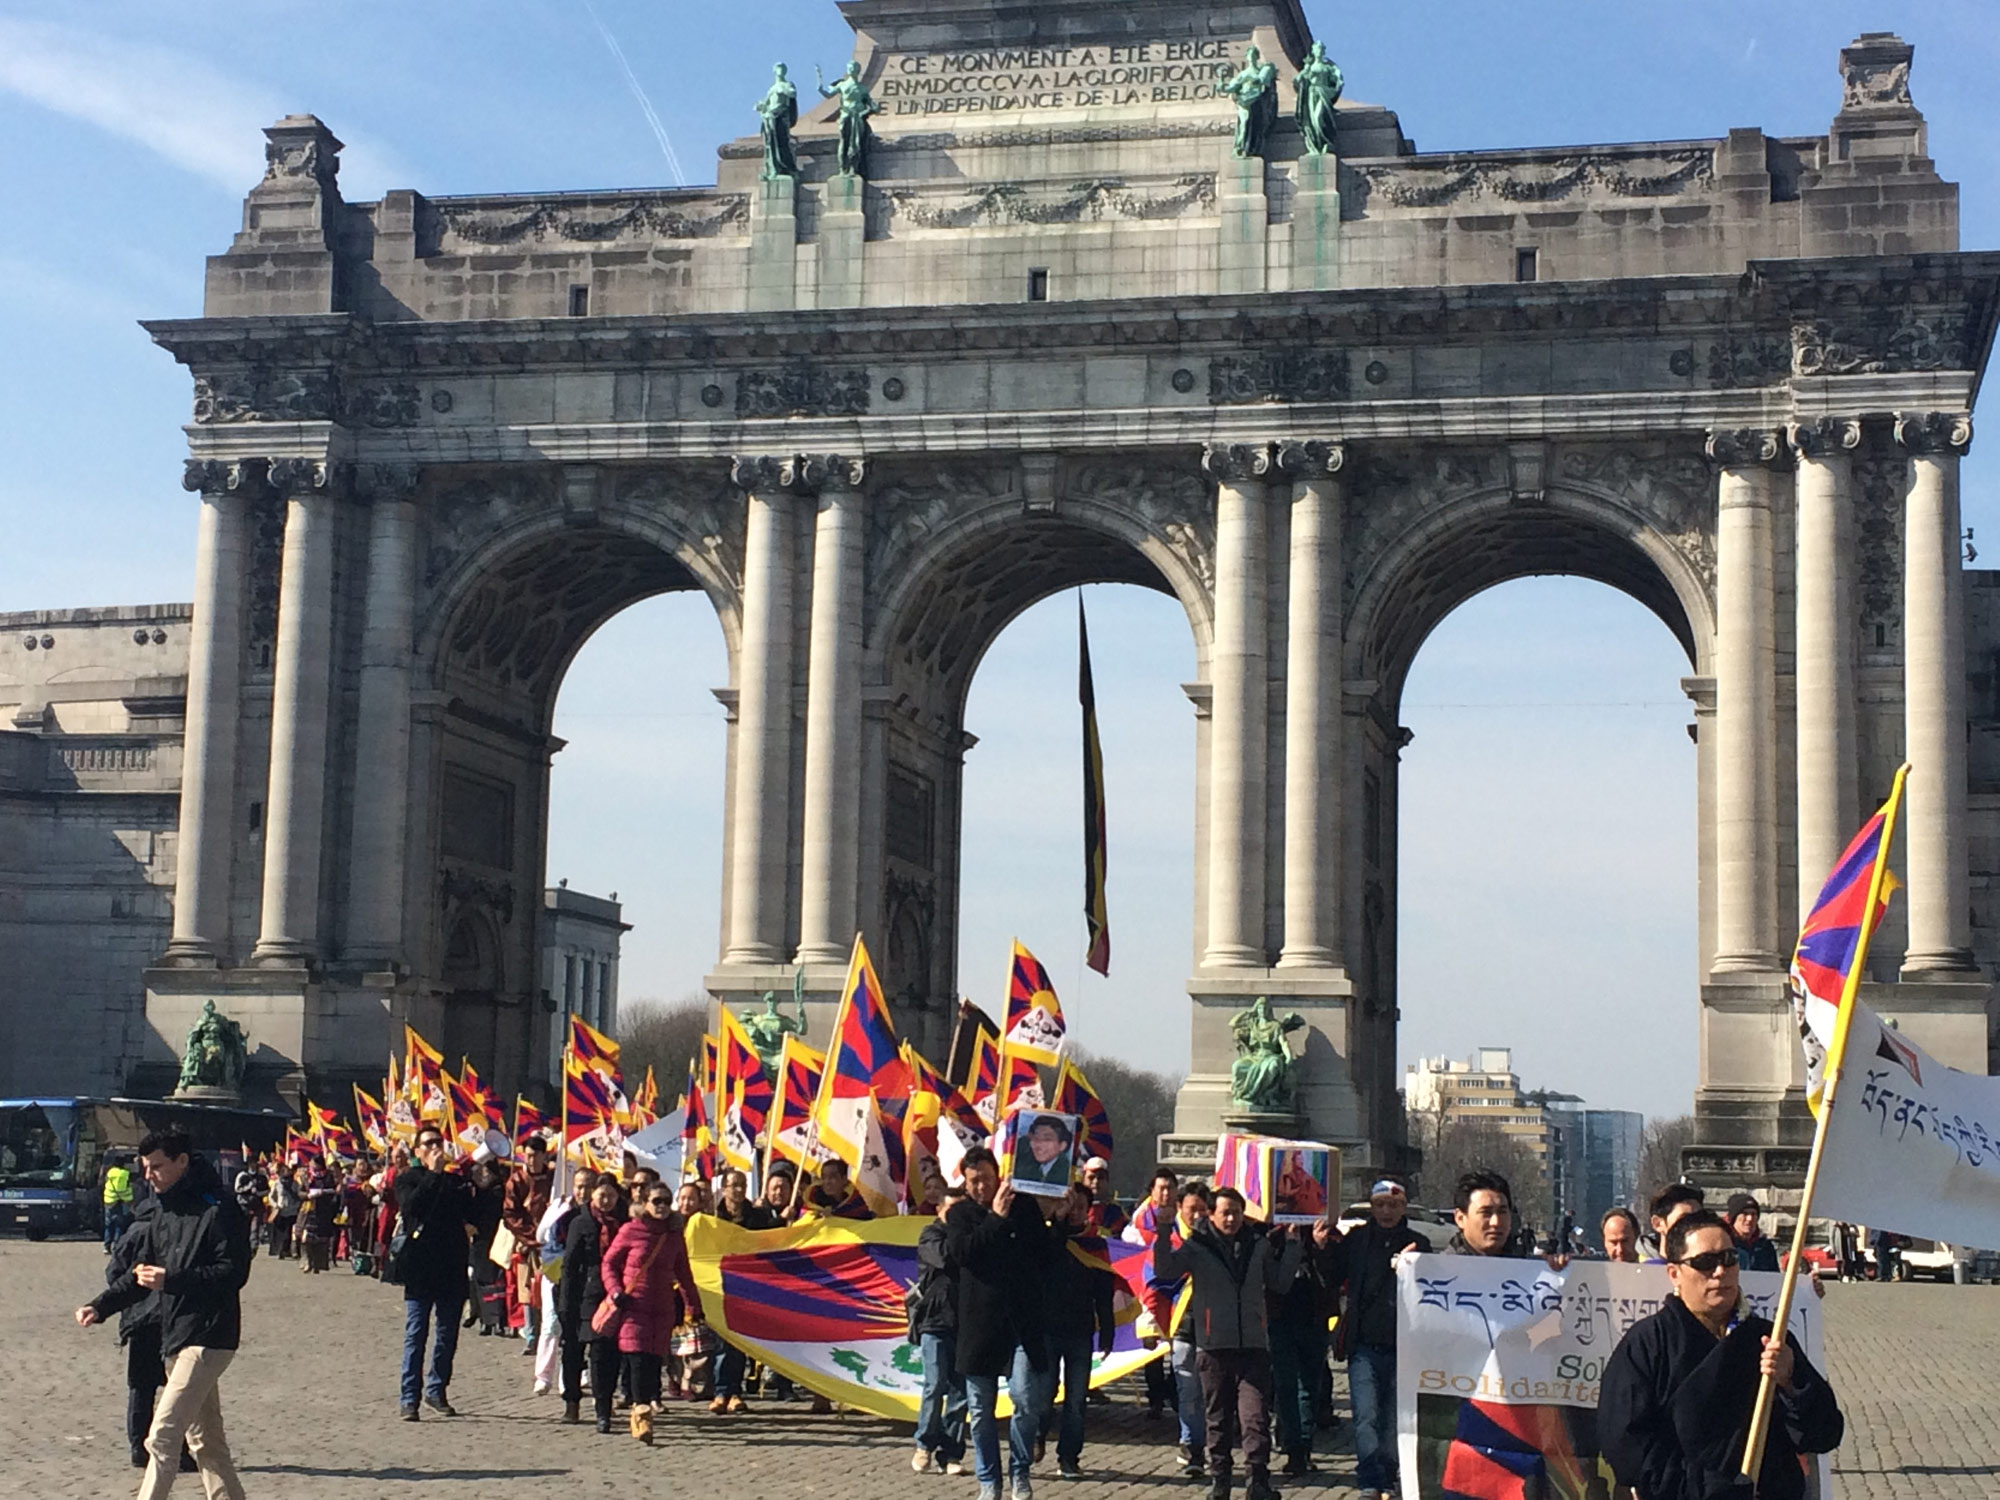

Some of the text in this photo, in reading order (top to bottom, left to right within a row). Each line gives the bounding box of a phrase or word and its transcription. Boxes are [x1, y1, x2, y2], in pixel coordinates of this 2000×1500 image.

[900, 40, 1230, 75] CE MONVMENT A ETE ERIGE
[1028, 73, 1048, 90] A
[1074, 90, 1103, 107] DE
[1112, 89, 1141, 105] LA
